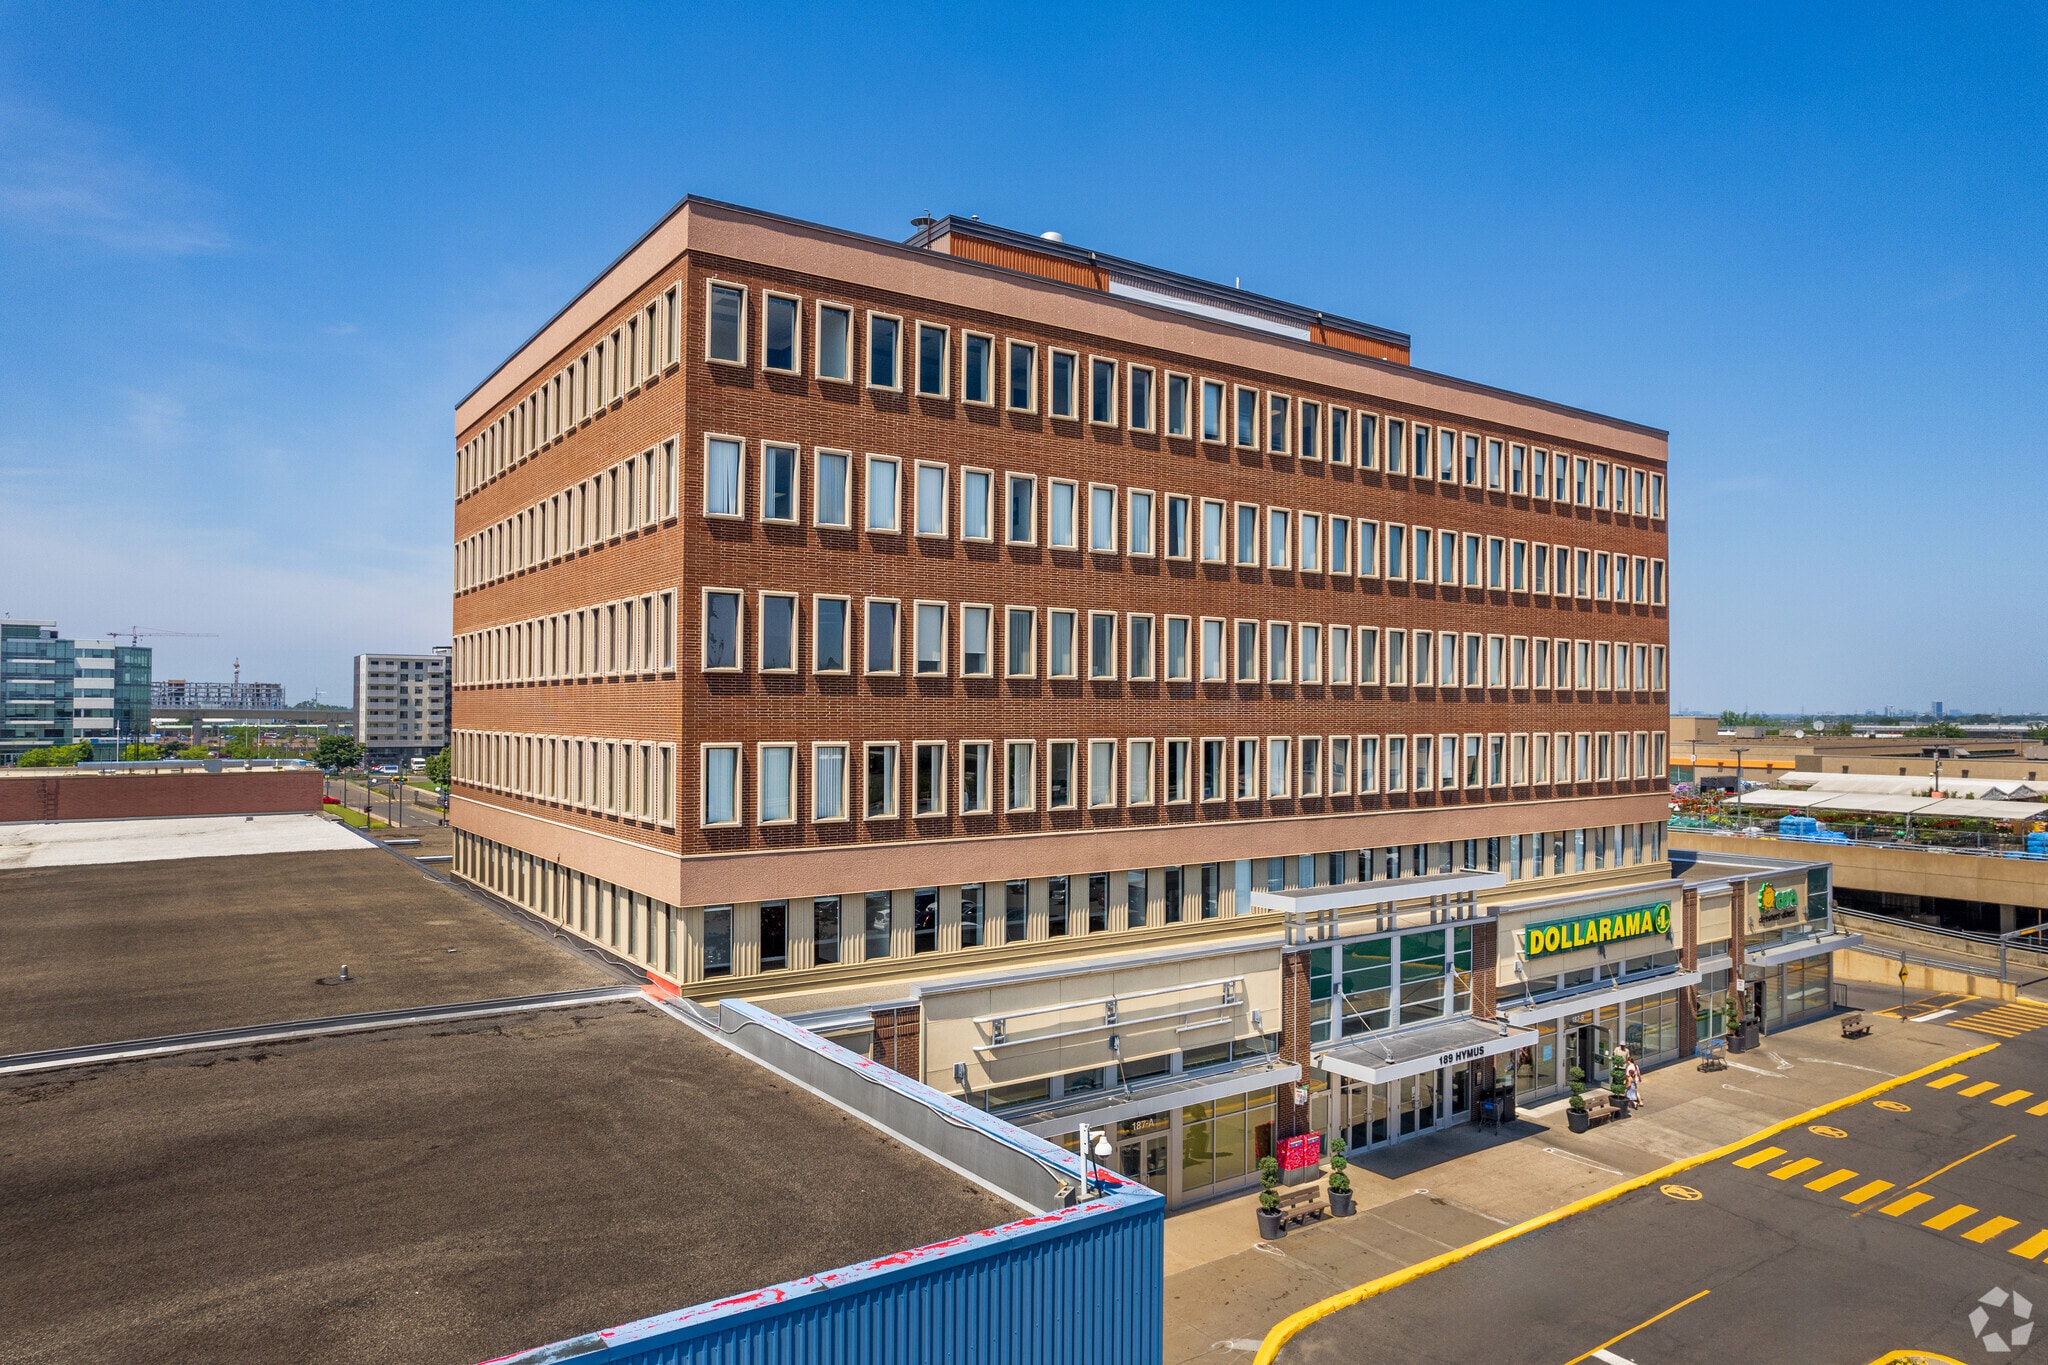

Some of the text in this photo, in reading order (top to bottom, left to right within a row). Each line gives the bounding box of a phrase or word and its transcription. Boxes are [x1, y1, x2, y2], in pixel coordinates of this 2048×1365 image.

[1529, 910, 1653, 955] DOLLARAMA
[1439, 1046, 1485, 1066] 189 HYMUS
[1131, 1118, 1154, 1131] 187-A
